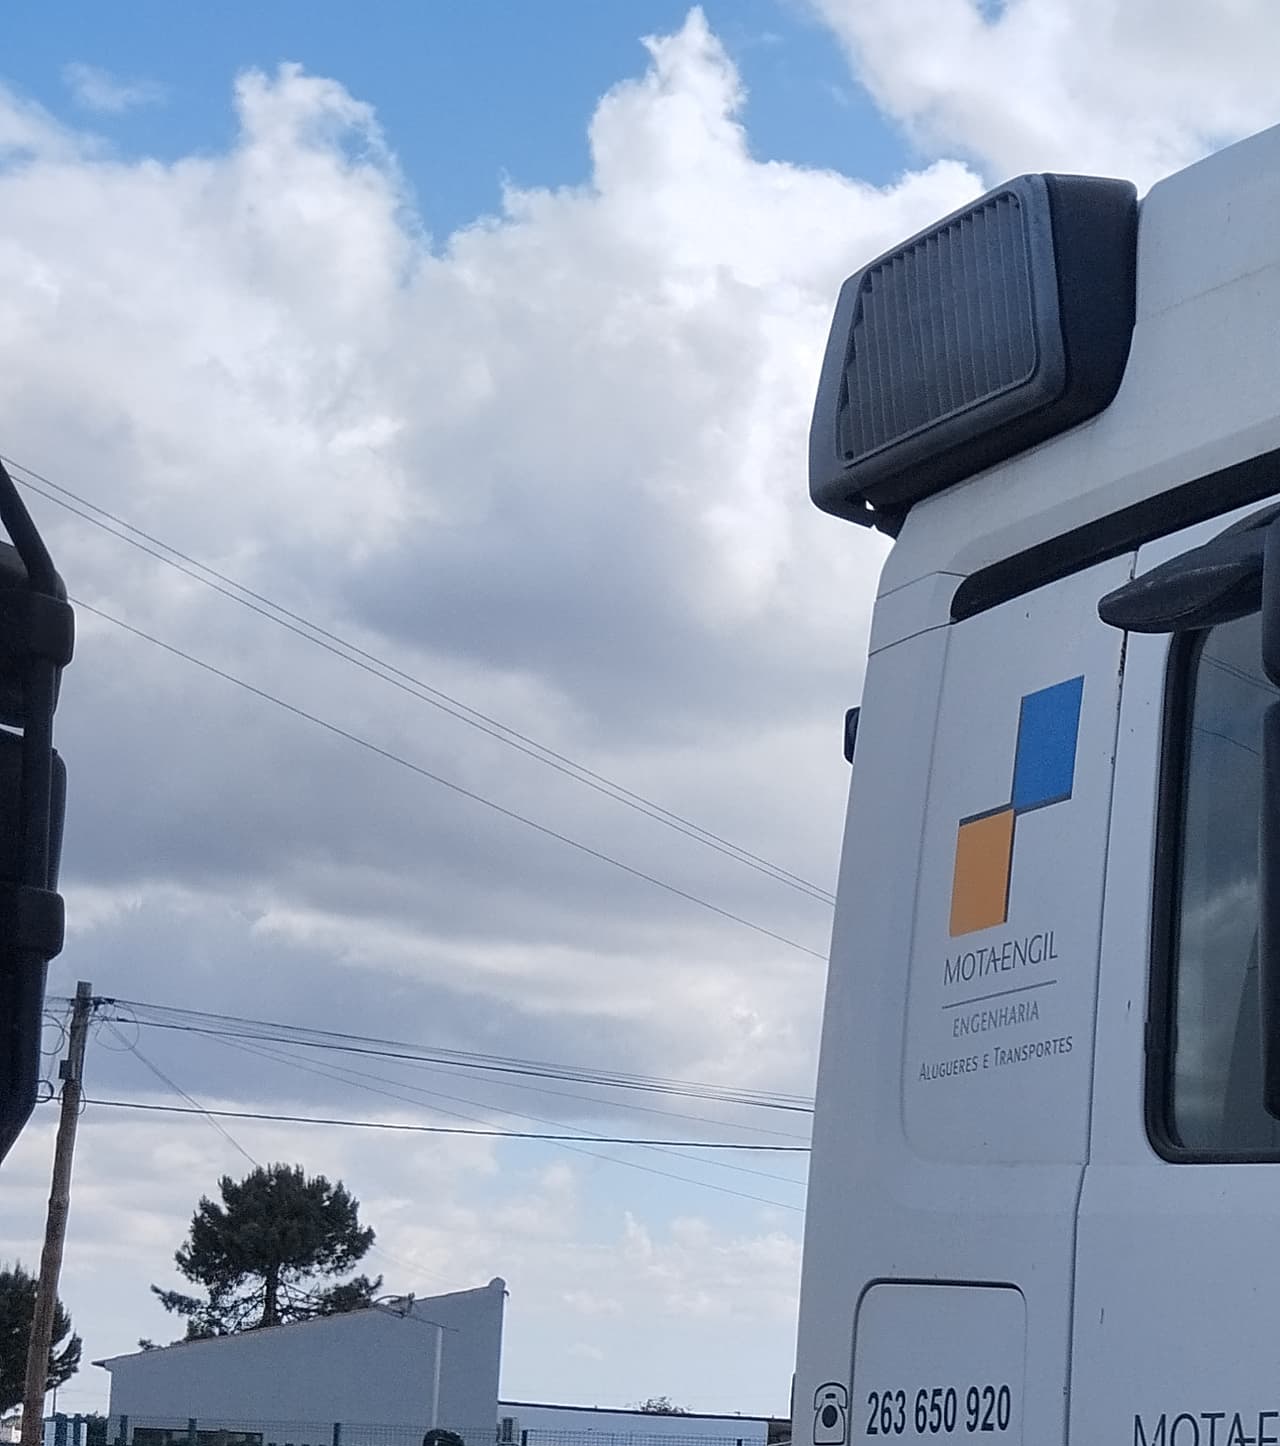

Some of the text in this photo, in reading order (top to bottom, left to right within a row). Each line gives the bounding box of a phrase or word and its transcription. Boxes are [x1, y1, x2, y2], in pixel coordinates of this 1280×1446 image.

[952, 1001, 1040, 1038] ENGENHARIA
[919, 1036, 1073, 1081] ALUGUERES E TRANSPORTES
[866, 1384, 1012, 1435] 263 650 920
